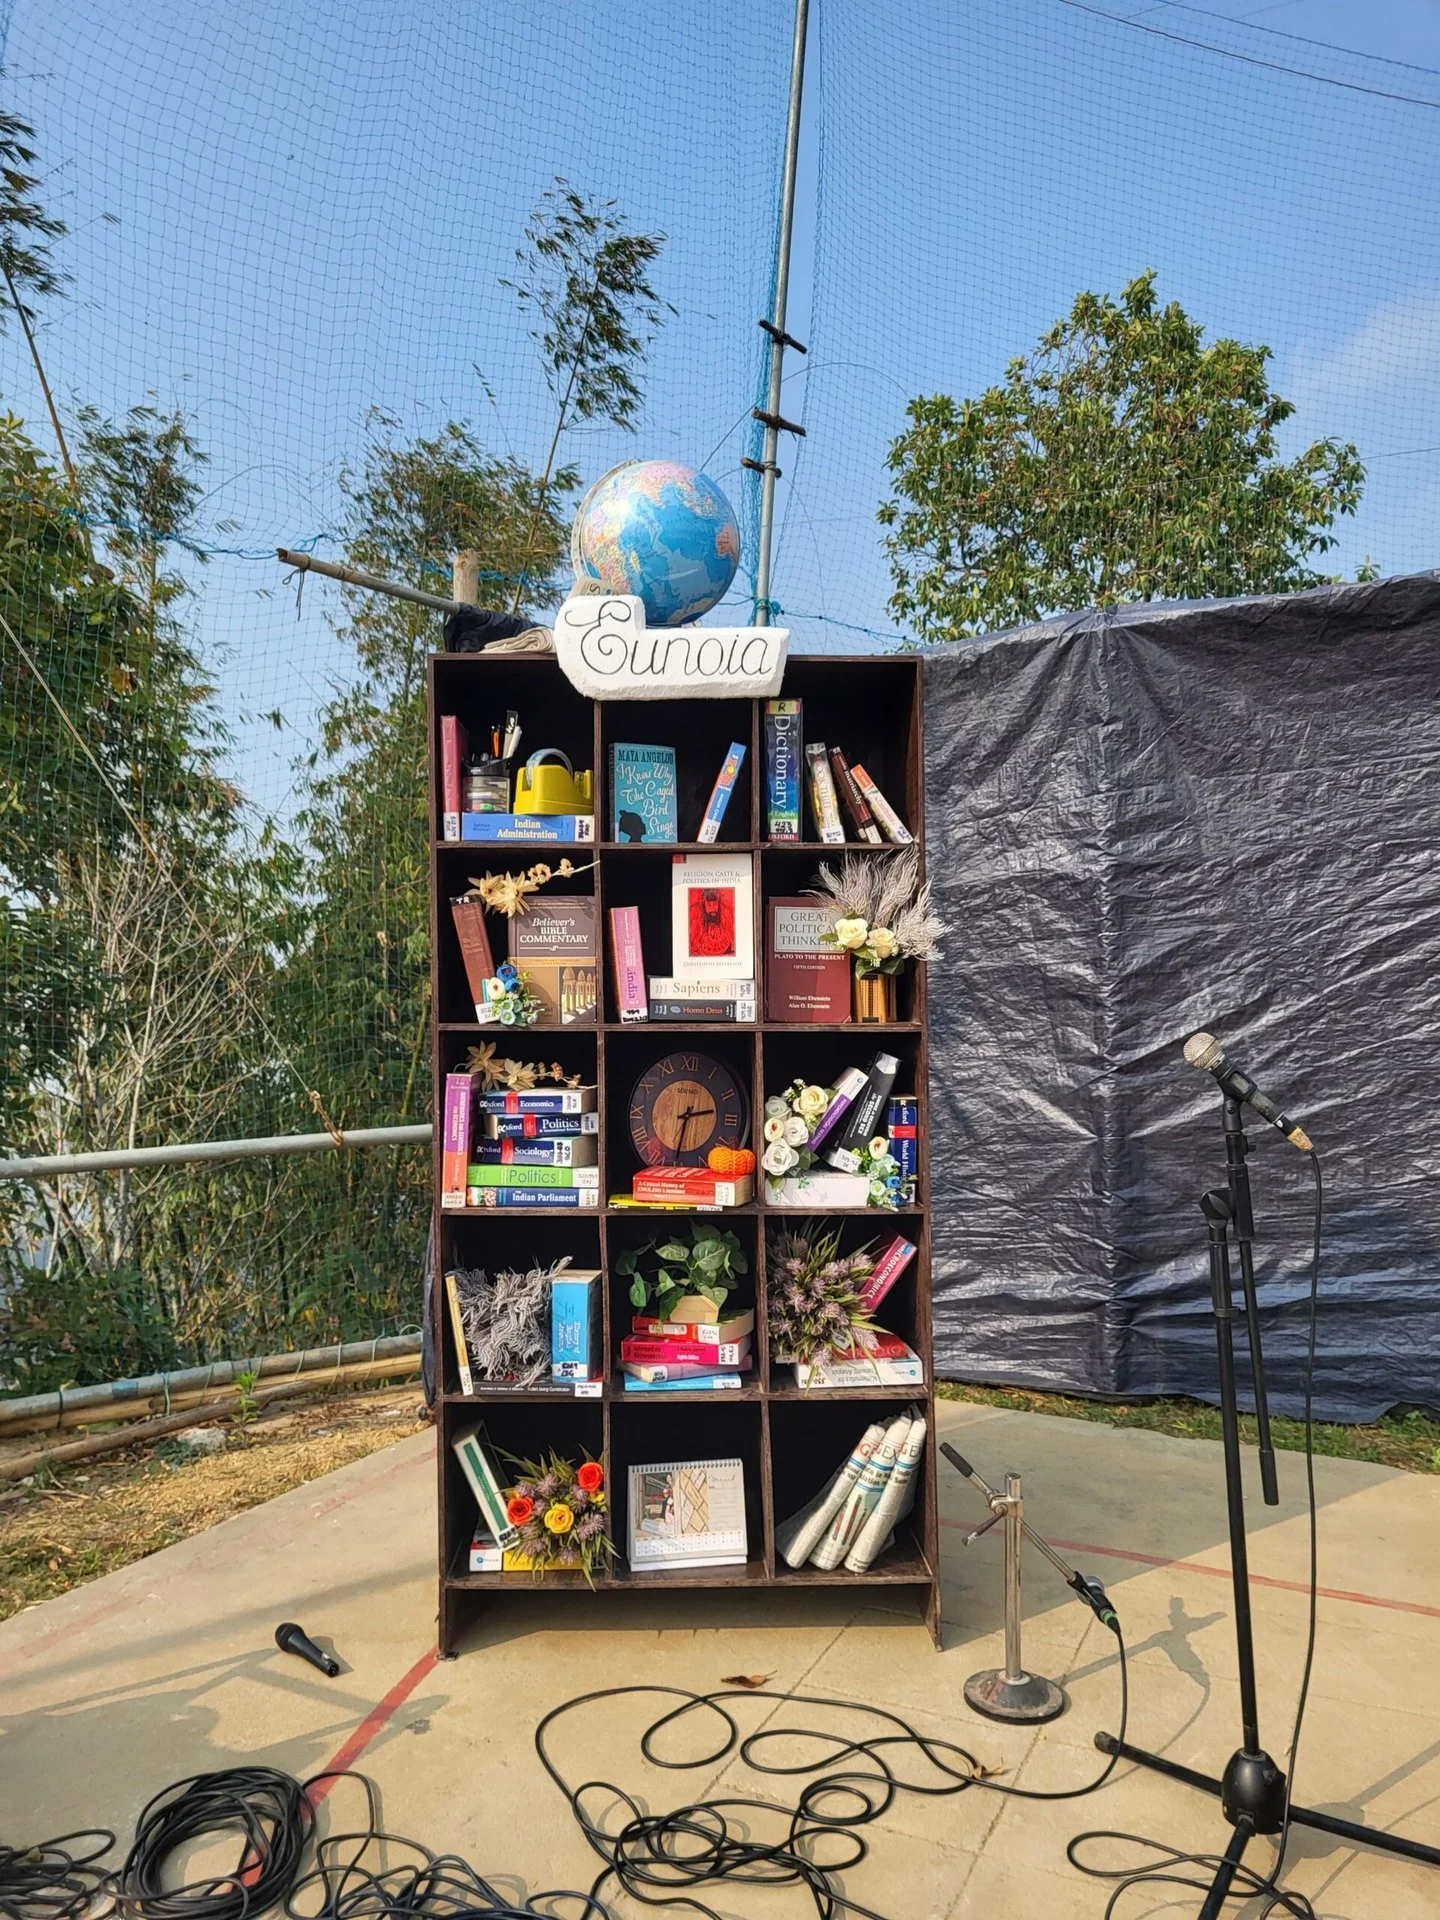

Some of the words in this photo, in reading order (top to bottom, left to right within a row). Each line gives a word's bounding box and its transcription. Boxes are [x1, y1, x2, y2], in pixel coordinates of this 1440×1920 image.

[565, 600, 772, 676] Eunoia
[778, 702, 786, 712] R
[618, 751, 639, 762] MAYA
[640, 751, 674, 764] ANGELOU
[771, 715, 791, 809] Dictionary
[626, 768, 651, 784] Know
[653, 764, 674, 785] Why
[621, 788, 644, 804] The
[645, 782, 674, 802] Caged
[845, 771, 863, 806] matriarchy
[641, 798, 669, 816] Bird
[514, 819, 541, 829] Indian
[649, 820, 674, 837] Sings
[497, 829, 558, 839] Administration
[532, 918, 576, 927] Believer's
[790, 912, 830, 922] GREAT
[540, 927, 568, 935] BIBLE
[779, 924, 834, 934] POLITICA
[520, 935, 589, 944] COMMENTARY
[673, 981, 721, 997] Sapiens
[657, 1059, 675, 1078] XI
[680, 1055, 701, 1072] XII
[638, 1077, 655, 1095] X
[720, 1088, 735, 1101] II
[542, 1119, 579, 1129] Politics
[724, 1113, 738, 1128] III
[515, 1146, 554, 1158] Sociology
[901, 1139, 909, 1162] World
[509, 1169, 556, 1184] Politics
[512, 1191, 537, 1202] Indian
[537, 1192, 577, 1203] Parliament
[868, 1244, 907, 1300] MICROECONOMICS
